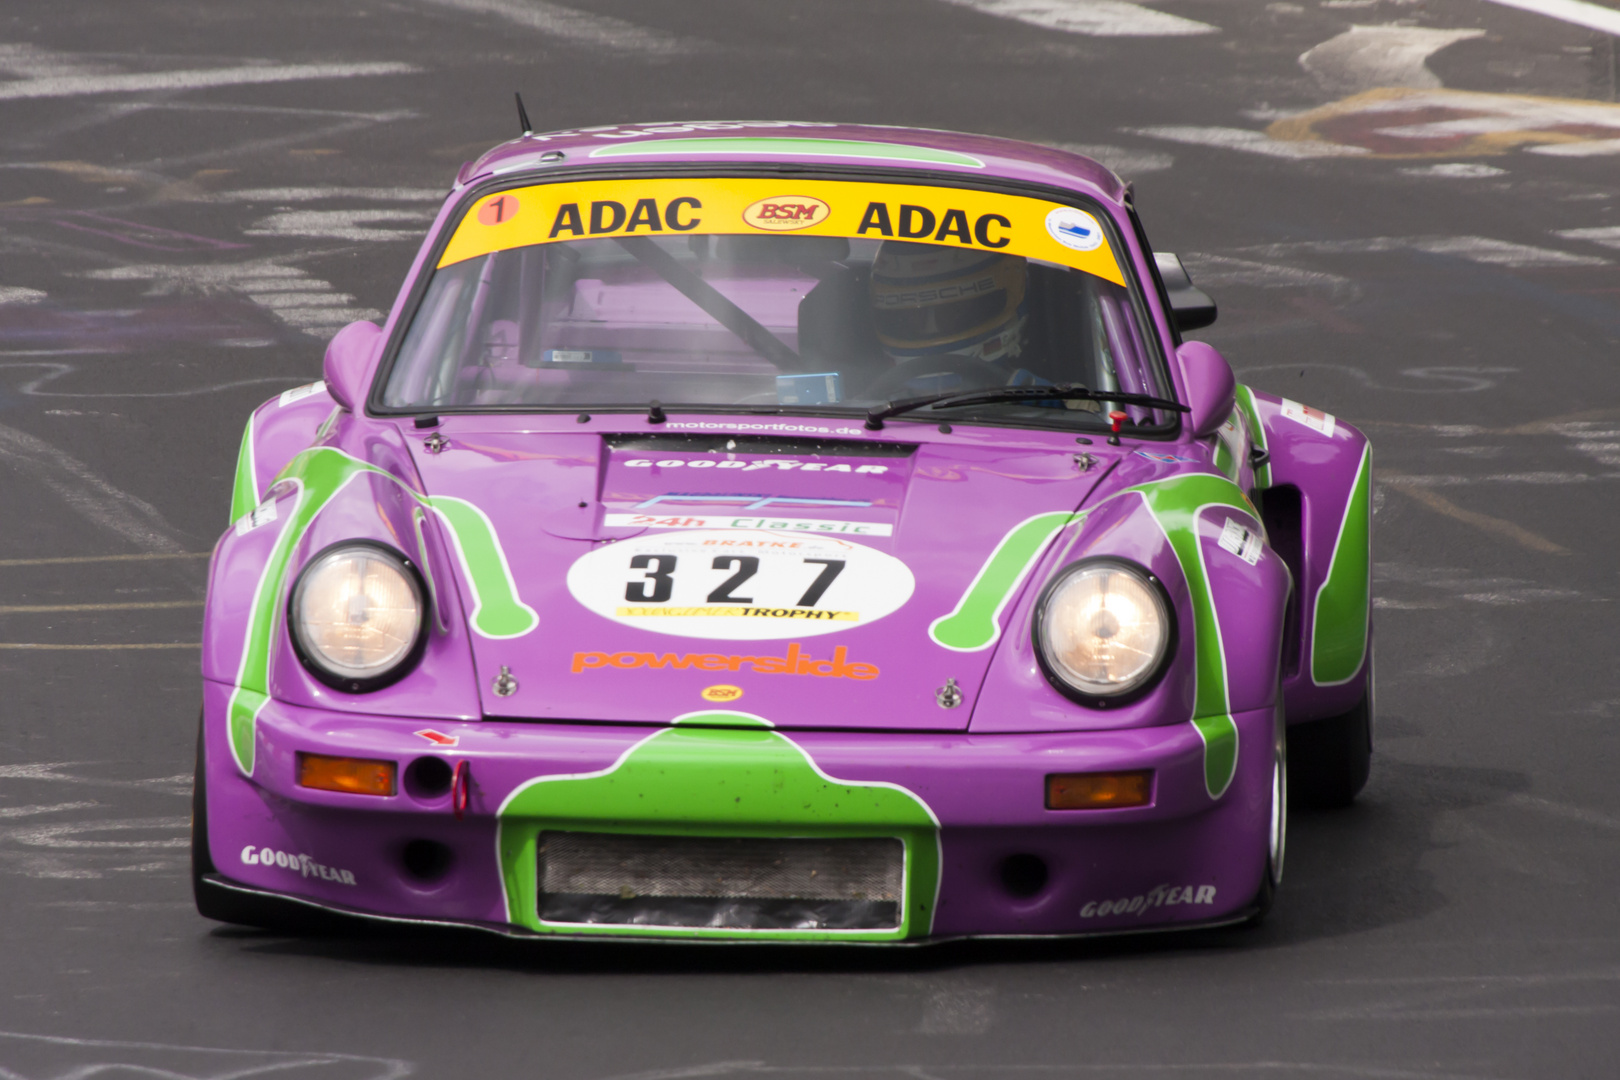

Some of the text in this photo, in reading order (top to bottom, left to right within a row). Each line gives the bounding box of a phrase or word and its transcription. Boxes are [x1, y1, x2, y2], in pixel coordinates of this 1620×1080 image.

[489, 197, 506, 223] 1
[548, 196, 702, 238] ADAC
[756, 203, 820, 220] BSM
[856, 201, 1012, 249] ADAC
[876, 277, 996, 306] PORSCHE
[665, 422, 862, 436] motorsportfotos.de
[623, 459, 889, 475] GOODYEAR
[628, 515, 870, 533] 24h Classic
[740, 607, 840, 620] TROPHY
[570, 643, 880, 680] powerslide
[241, 844, 357, 886] GOODYEAR
[1079, 882, 1217, 918] GOODYEAR
